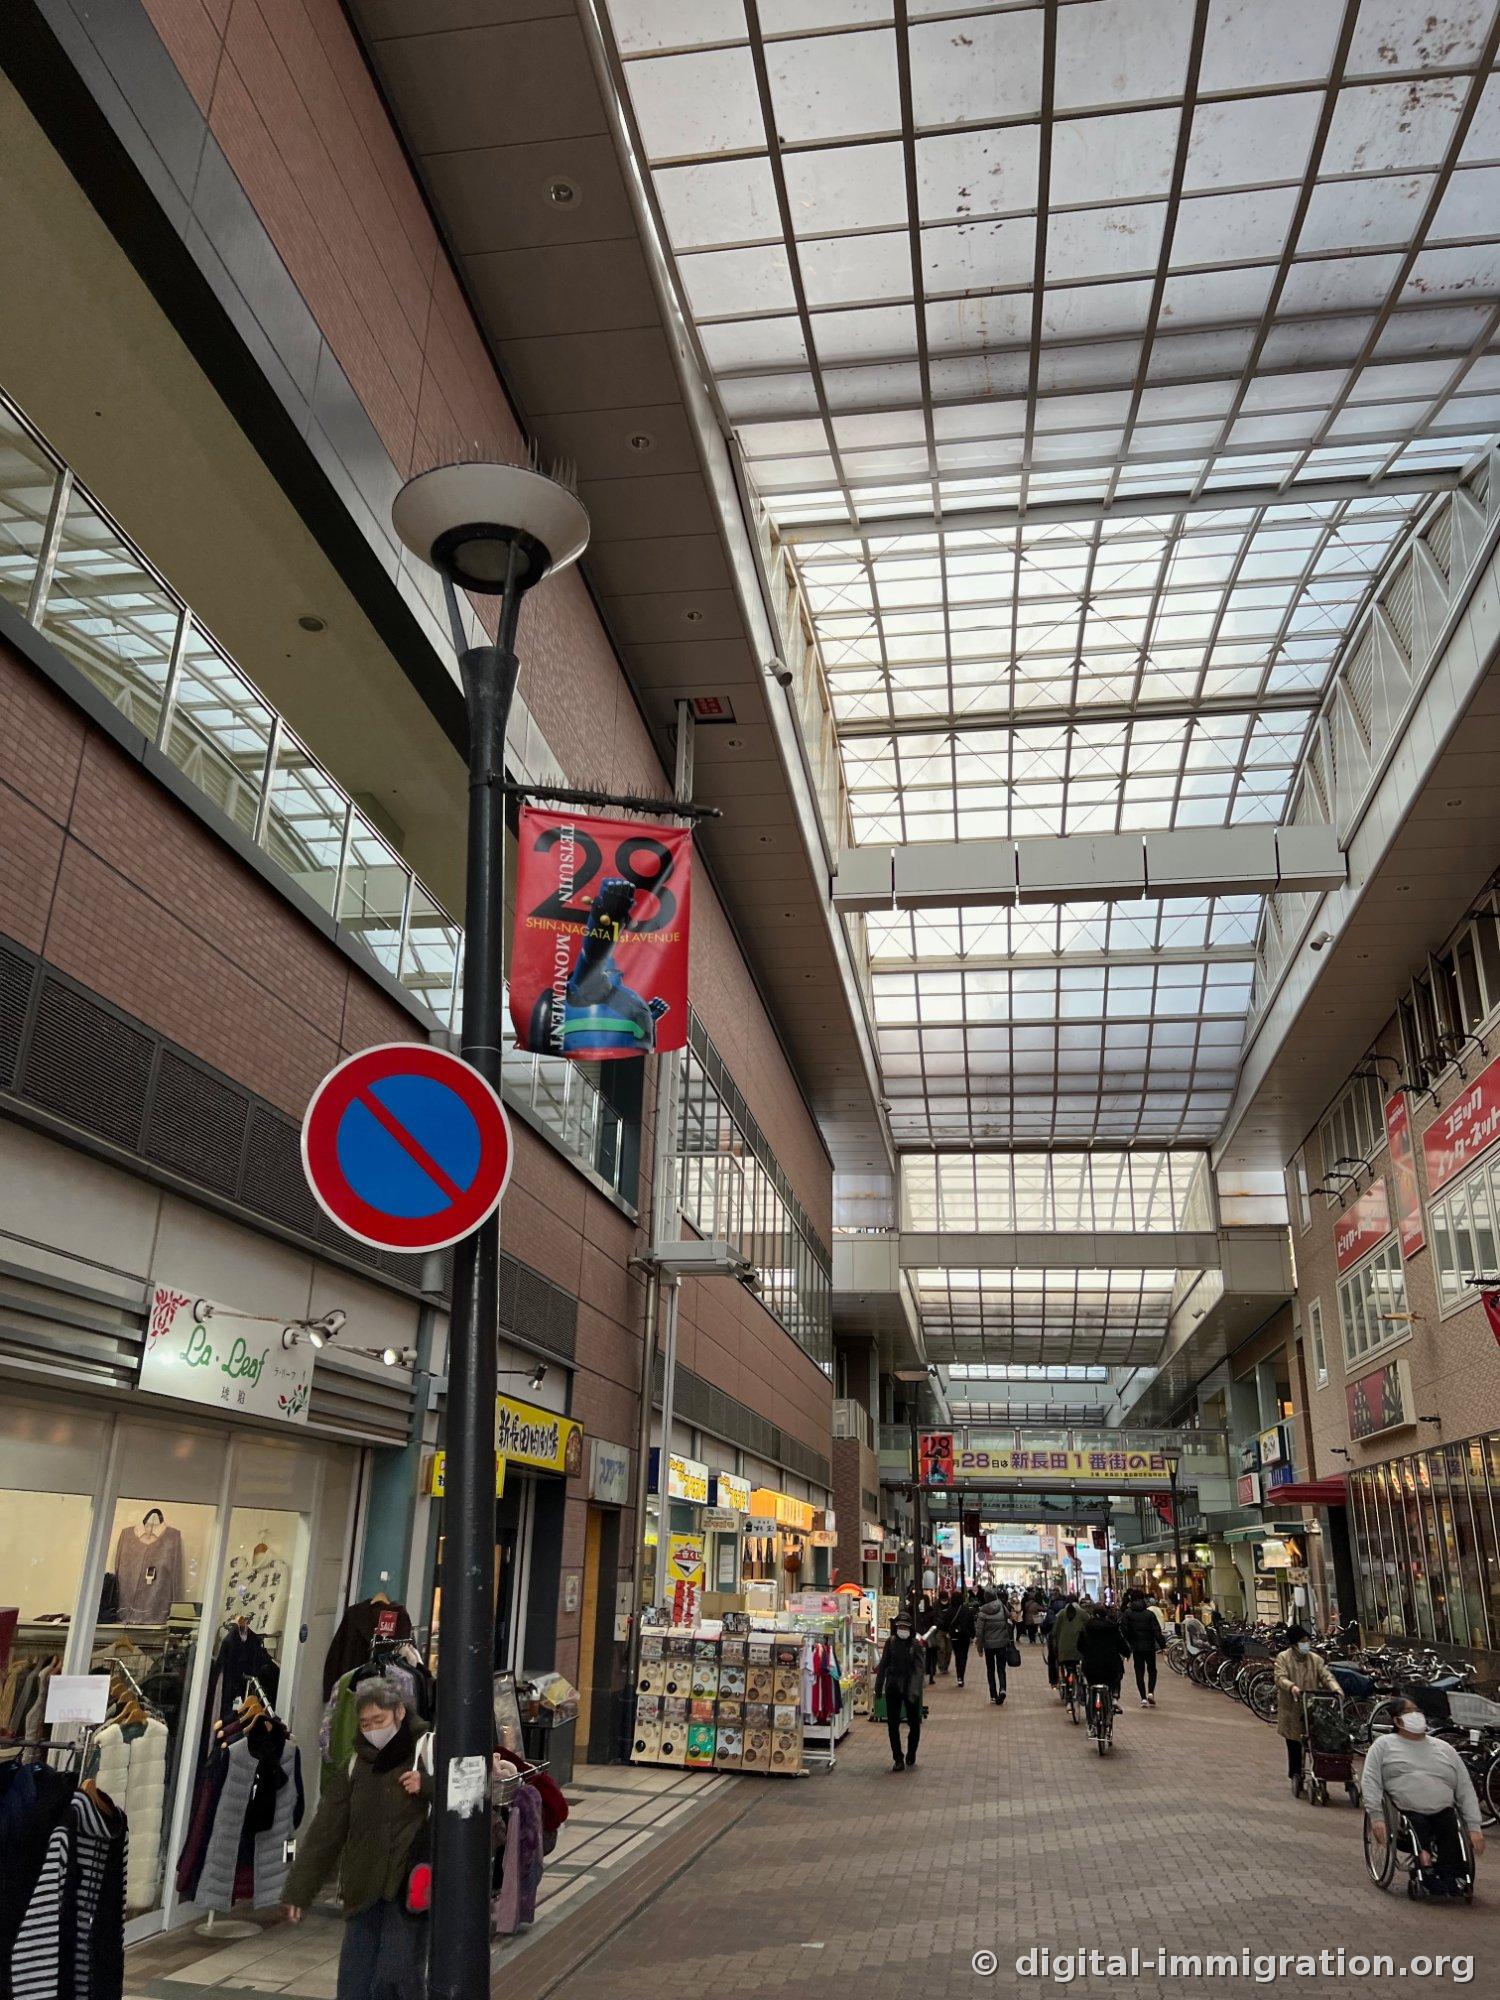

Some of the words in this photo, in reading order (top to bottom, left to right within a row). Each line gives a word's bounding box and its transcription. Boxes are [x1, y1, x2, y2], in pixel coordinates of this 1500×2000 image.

[528, 828, 676, 932] 28
[558, 823, 576, 903] TETSUJIN
[525, 917, 611, 942] SHIN-NAGATA
[549, 934, 571, 1050] MONUMENT
[1445, 1086, 1482, 1140] コミック
